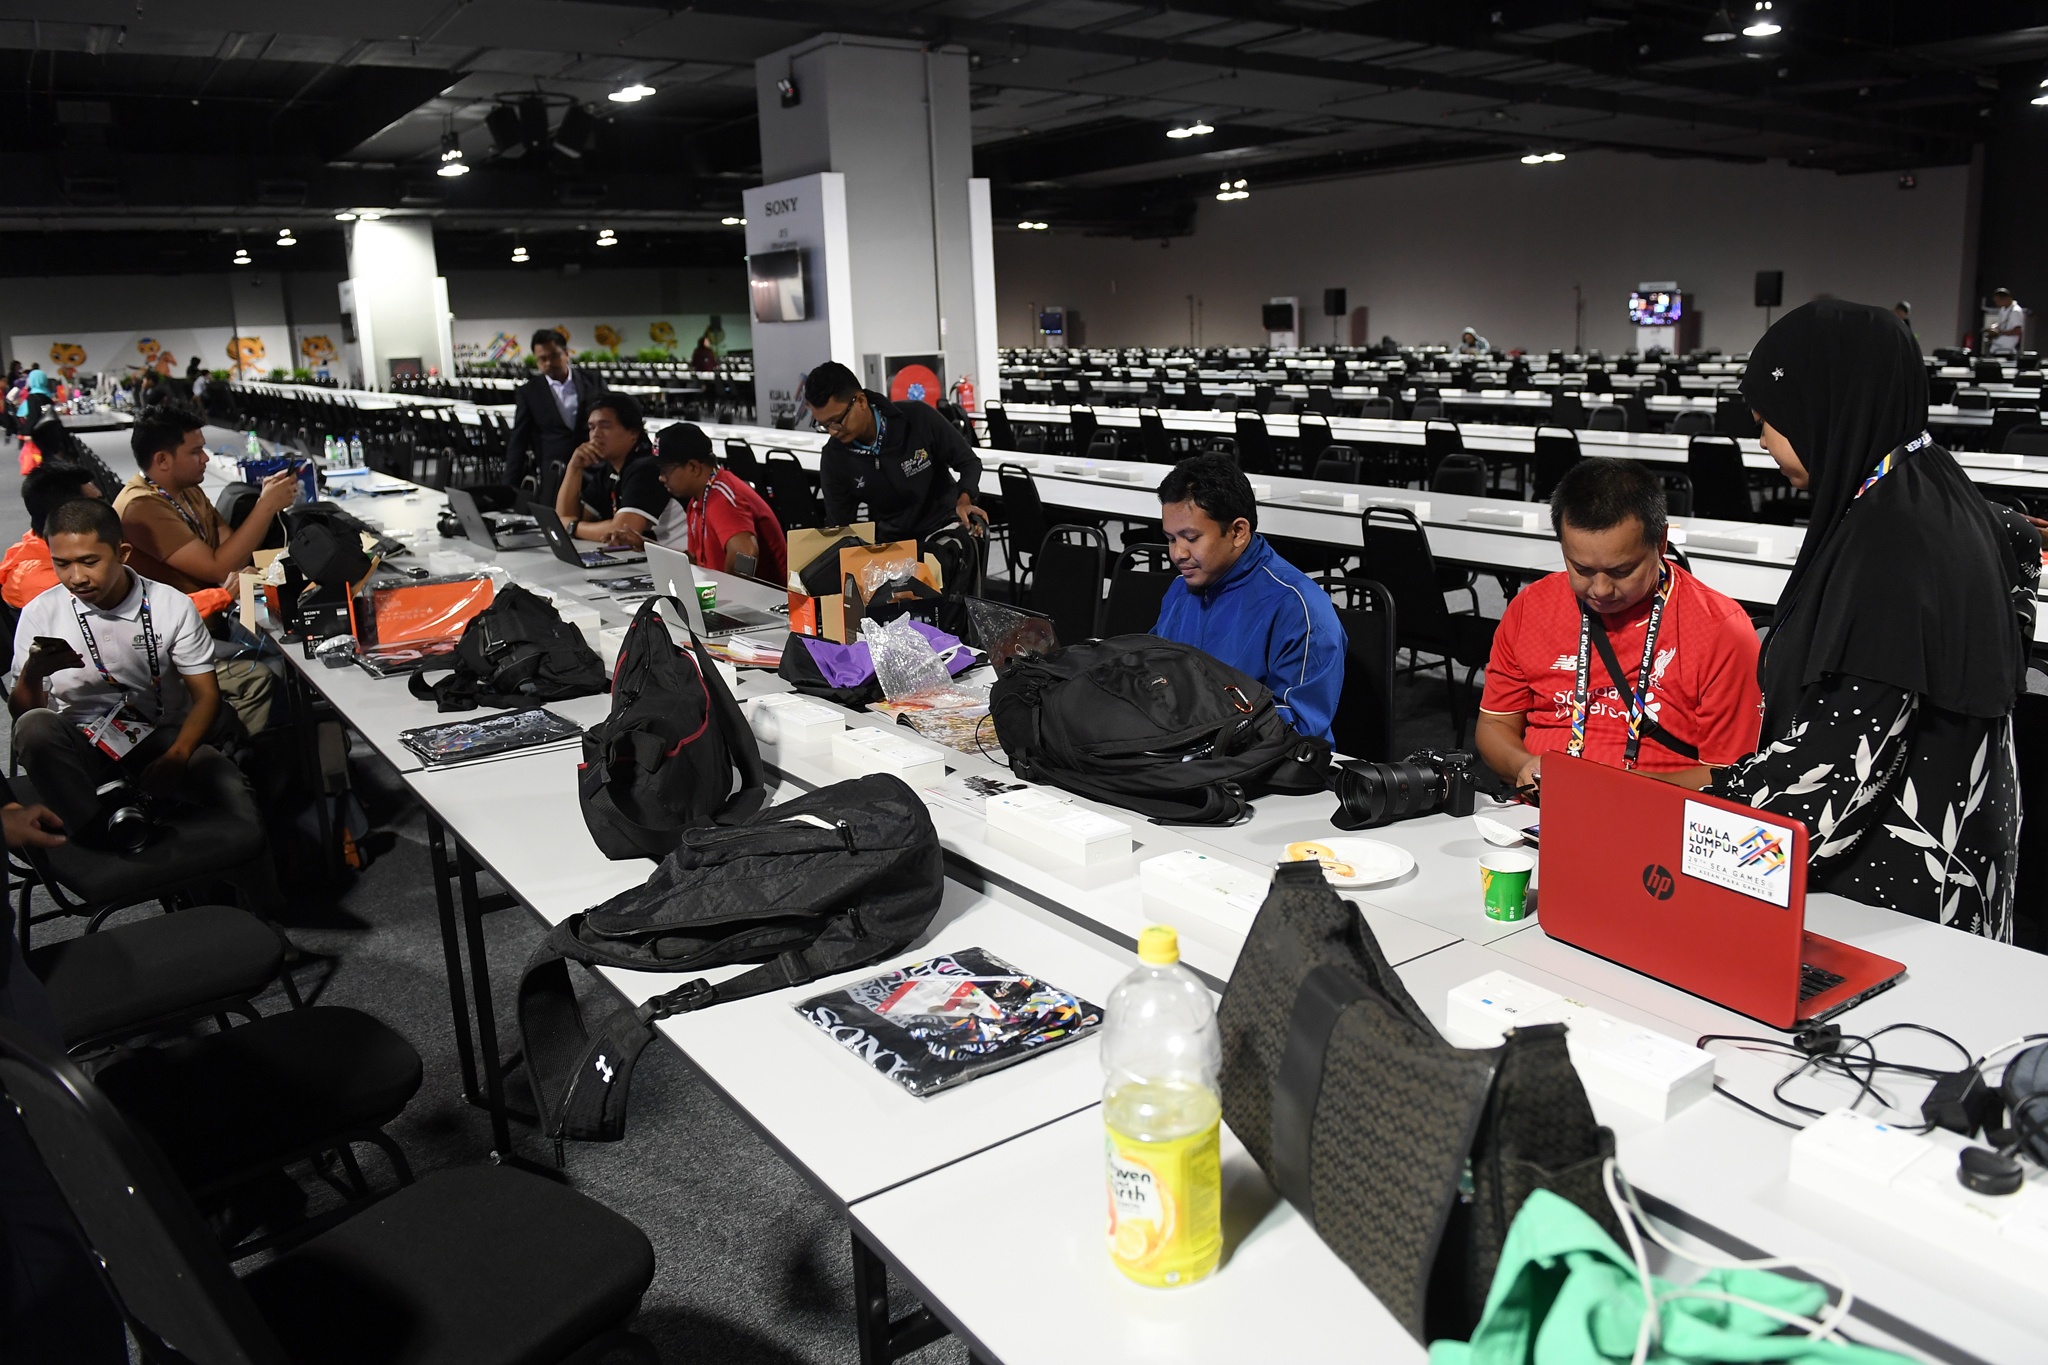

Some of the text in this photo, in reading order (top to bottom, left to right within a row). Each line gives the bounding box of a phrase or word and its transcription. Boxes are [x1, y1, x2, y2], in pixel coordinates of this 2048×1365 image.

[765, 197, 798, 217] SONY
[1649, 604, 1660, 632] KUALA
[1579, 634, 1589, 668] LUMPUR
[1640, 634, 1655, 667] LUMPUR
[1577, 669, 1586, 695] KUALA
[1689, 821, 1730, 842] KUALA
[1689, 832, 1739, 856] LUMPUR
[1689, 843, 1714, 858] 2017
[1646, 864, 1672, 899] hp
[1699, 870, 1720, 879] ASEAN
[1722, 877, 1740, 886] PARA
[1743, 884, 1765, 895] GAMES
[1710, 863, 1727, 873] SEA
[1732, 871, 1766, 887] GAMES
[808, 1006, 918, 1078] SONY
